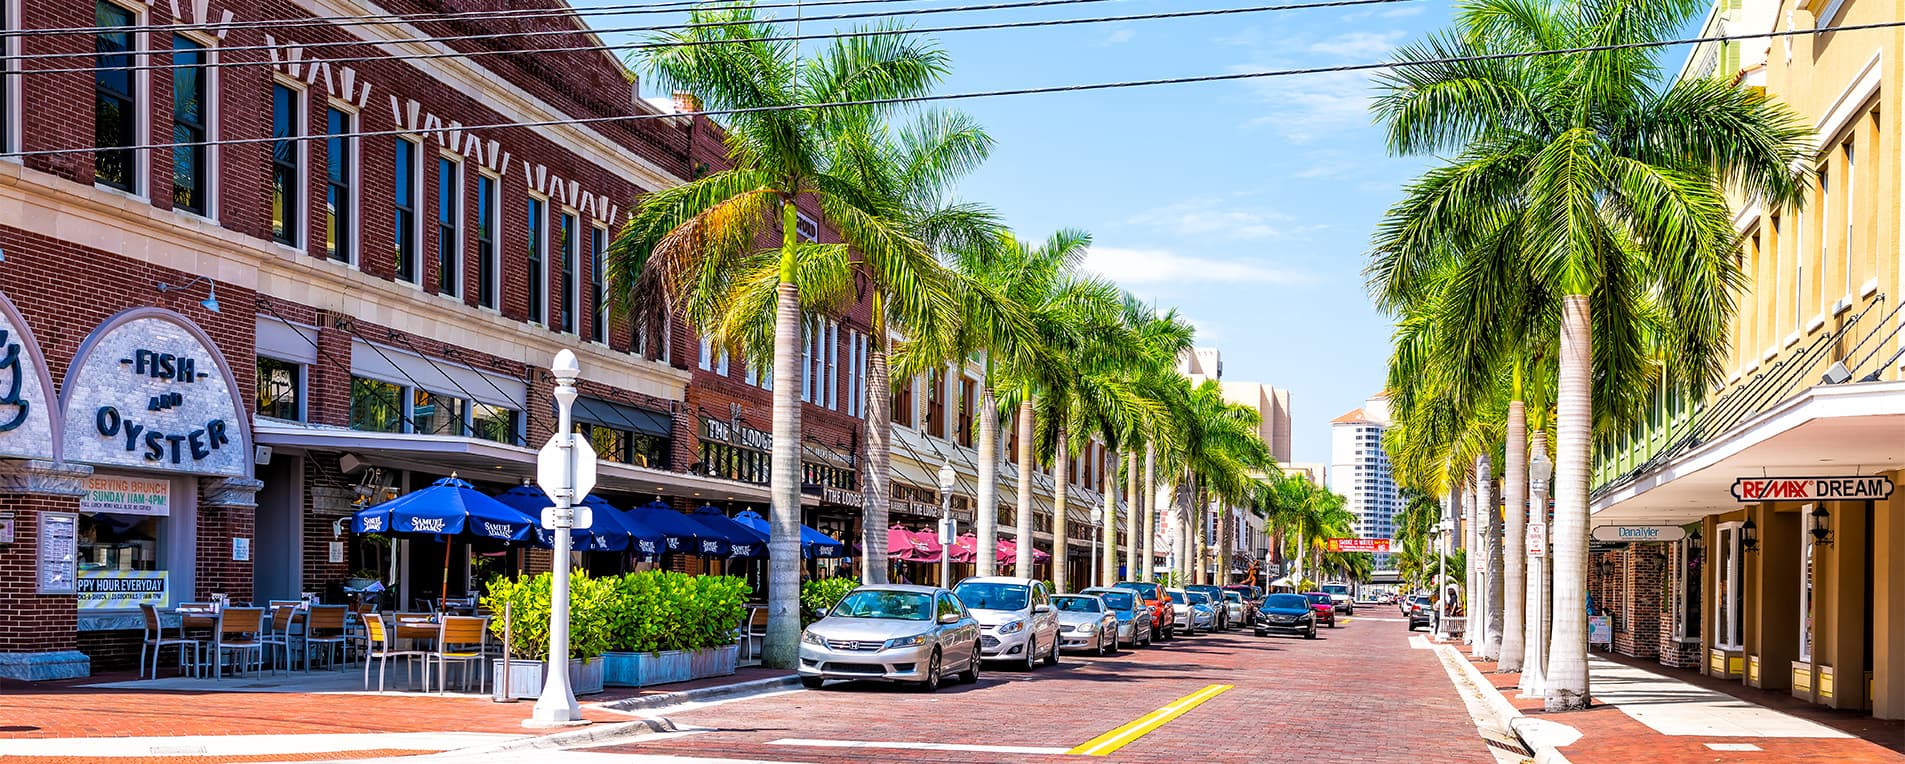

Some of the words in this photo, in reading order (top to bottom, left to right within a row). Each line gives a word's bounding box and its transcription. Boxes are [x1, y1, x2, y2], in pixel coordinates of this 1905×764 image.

[148, 392, 182, 411] AND
[97, 406, 229, 464] OYSTER
[708, 419, 728, 440] THE
[742, 427, 772, 450] LODGE
[89, 478, 128, 491] SERVING
[131, 481, 166, 494] BRUNCH
[1816, 480, 1883, 497] DREAM
[93, 491, 125, 503] SUNDAY
[828, 489, 840, 503] THE
[842, 491, 861, 507] LODGE
[913, 503, 922, 516] THE
[923, 503, 937, 518] LODGE
[411, 517, 445, 527] SAMUEL
[413, 523, 445, 532] ADAMS
[484, 522, 511, 533] SAMUEL
[488, 529, 512, 539] ADAMS
[97, 579, 120, 591] HOUR
[121, 579, 162, 591] EVERYDAY
